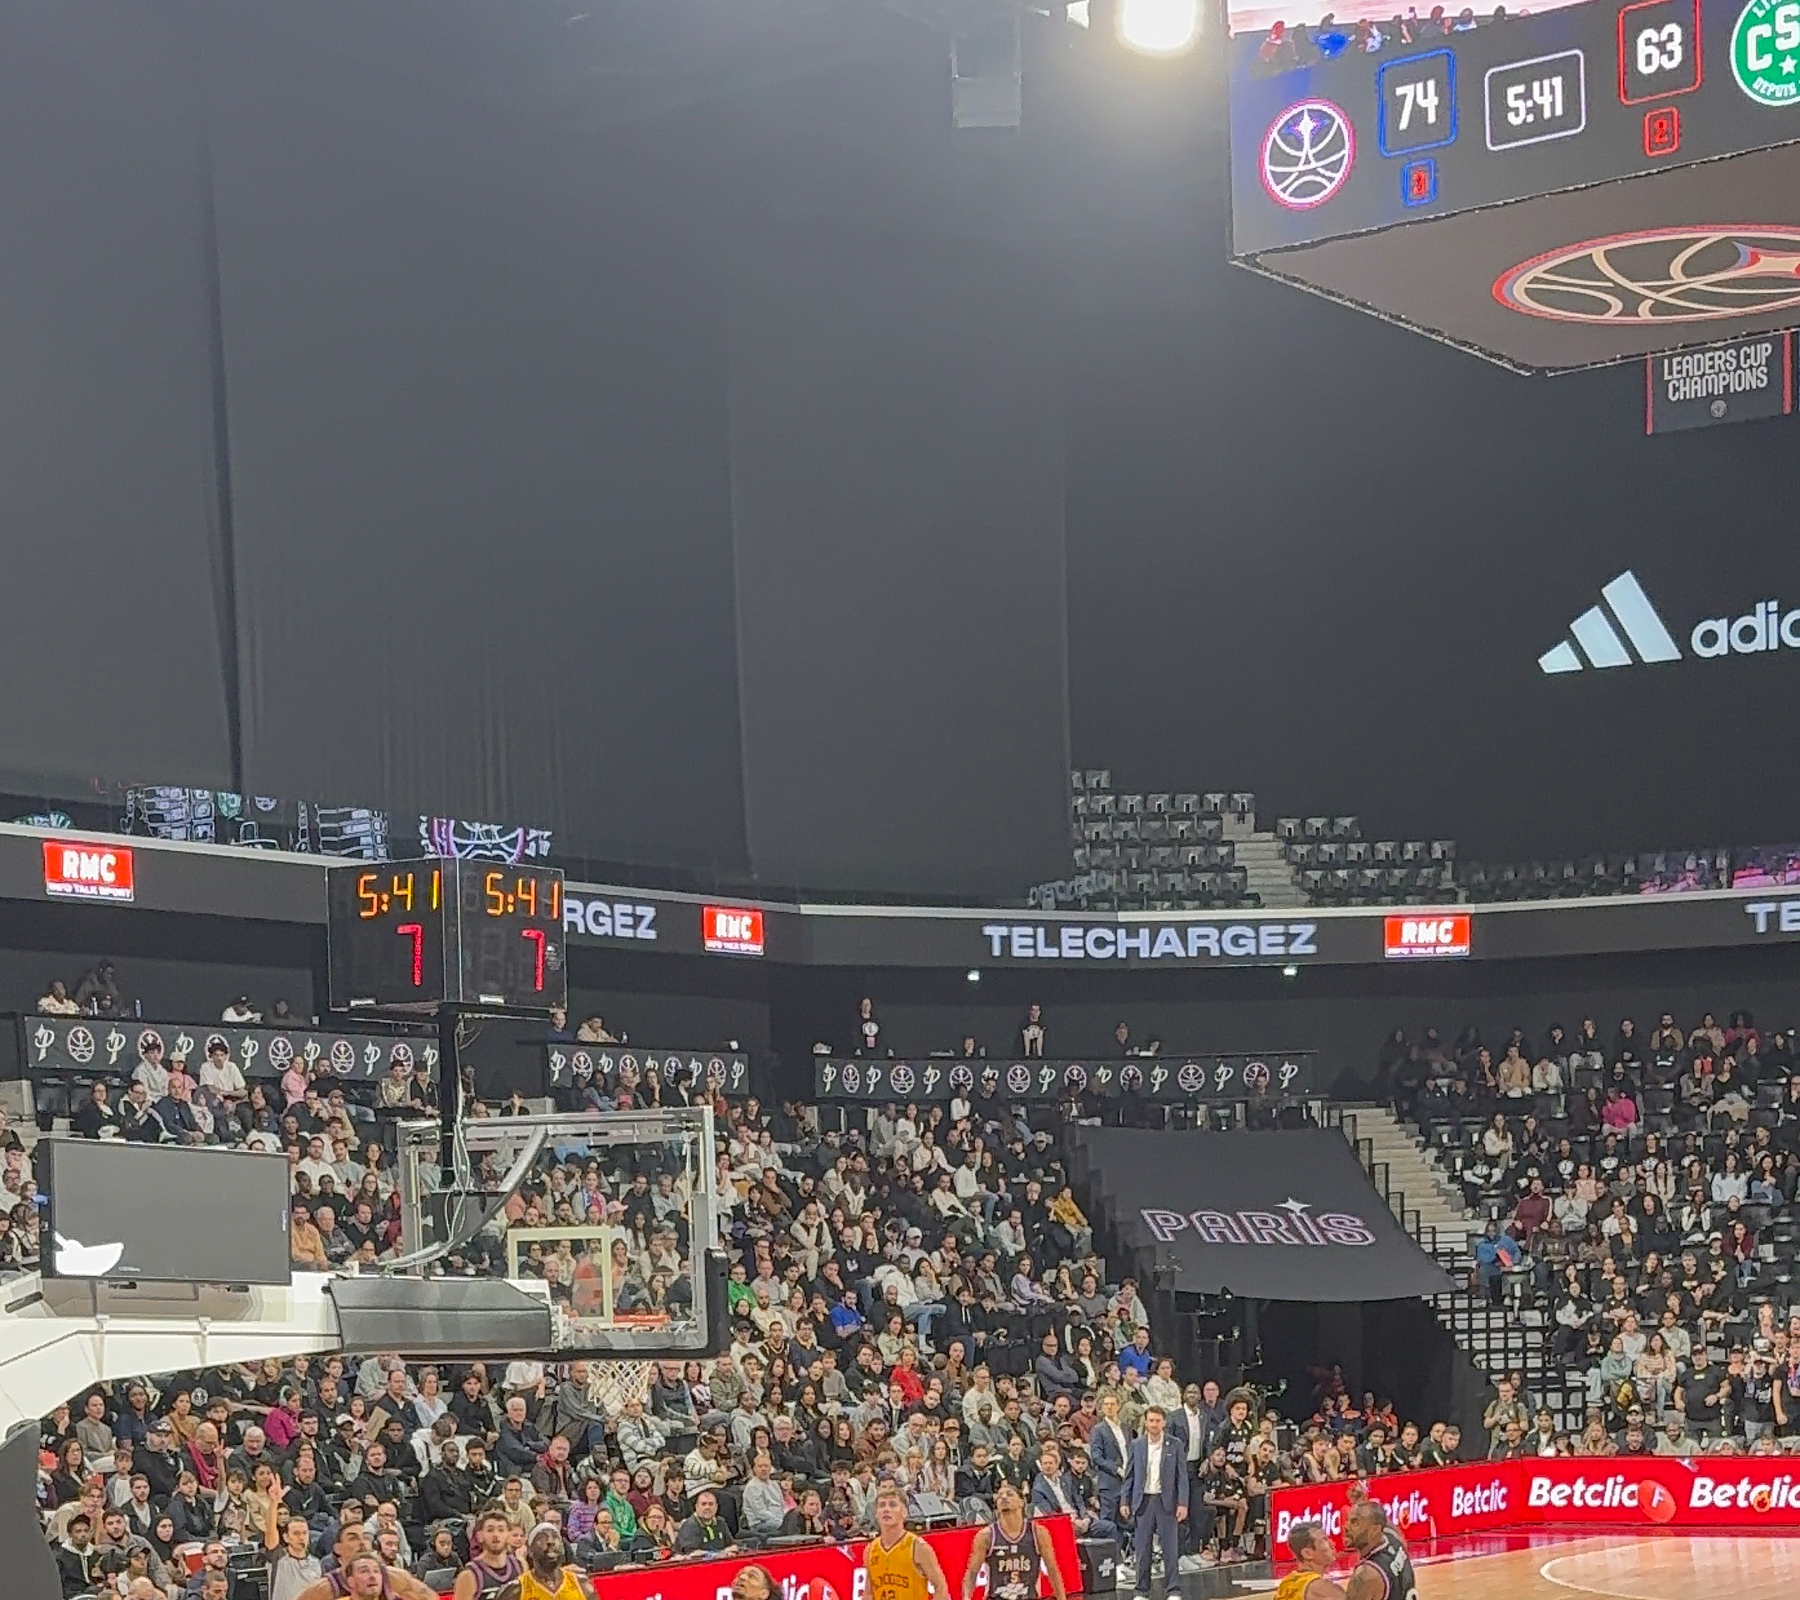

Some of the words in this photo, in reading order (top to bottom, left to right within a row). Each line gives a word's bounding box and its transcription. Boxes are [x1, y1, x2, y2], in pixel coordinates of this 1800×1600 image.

[1636, 22, 1683, 74] 63
[1395, 78, 1439, 131] 74
[1506, 75, 1565, 127] 5:41
[1653, 116, 1669, 144] 2
[1663, 349, 1738, 381] LEADERS
[1740, 342, 1773, 369] CUP
[1668, 366, 1768, 402] CHAMPIONS
[62, 850, 117, 884] RMC
[357, 869, 441, 919] 5:41
[486, 871, 560, 920] 5:41
[982, 923, 1317, 959] TELECHARGEZ
[1401, 920, 1455, 944] RMC
[396, 923, 423, 986] 7
[520, 927, 546, 991] 7
[1140, 1208, 1376, 1246] PARIS
[1451, 1479, 1508, 1518] Betclic
